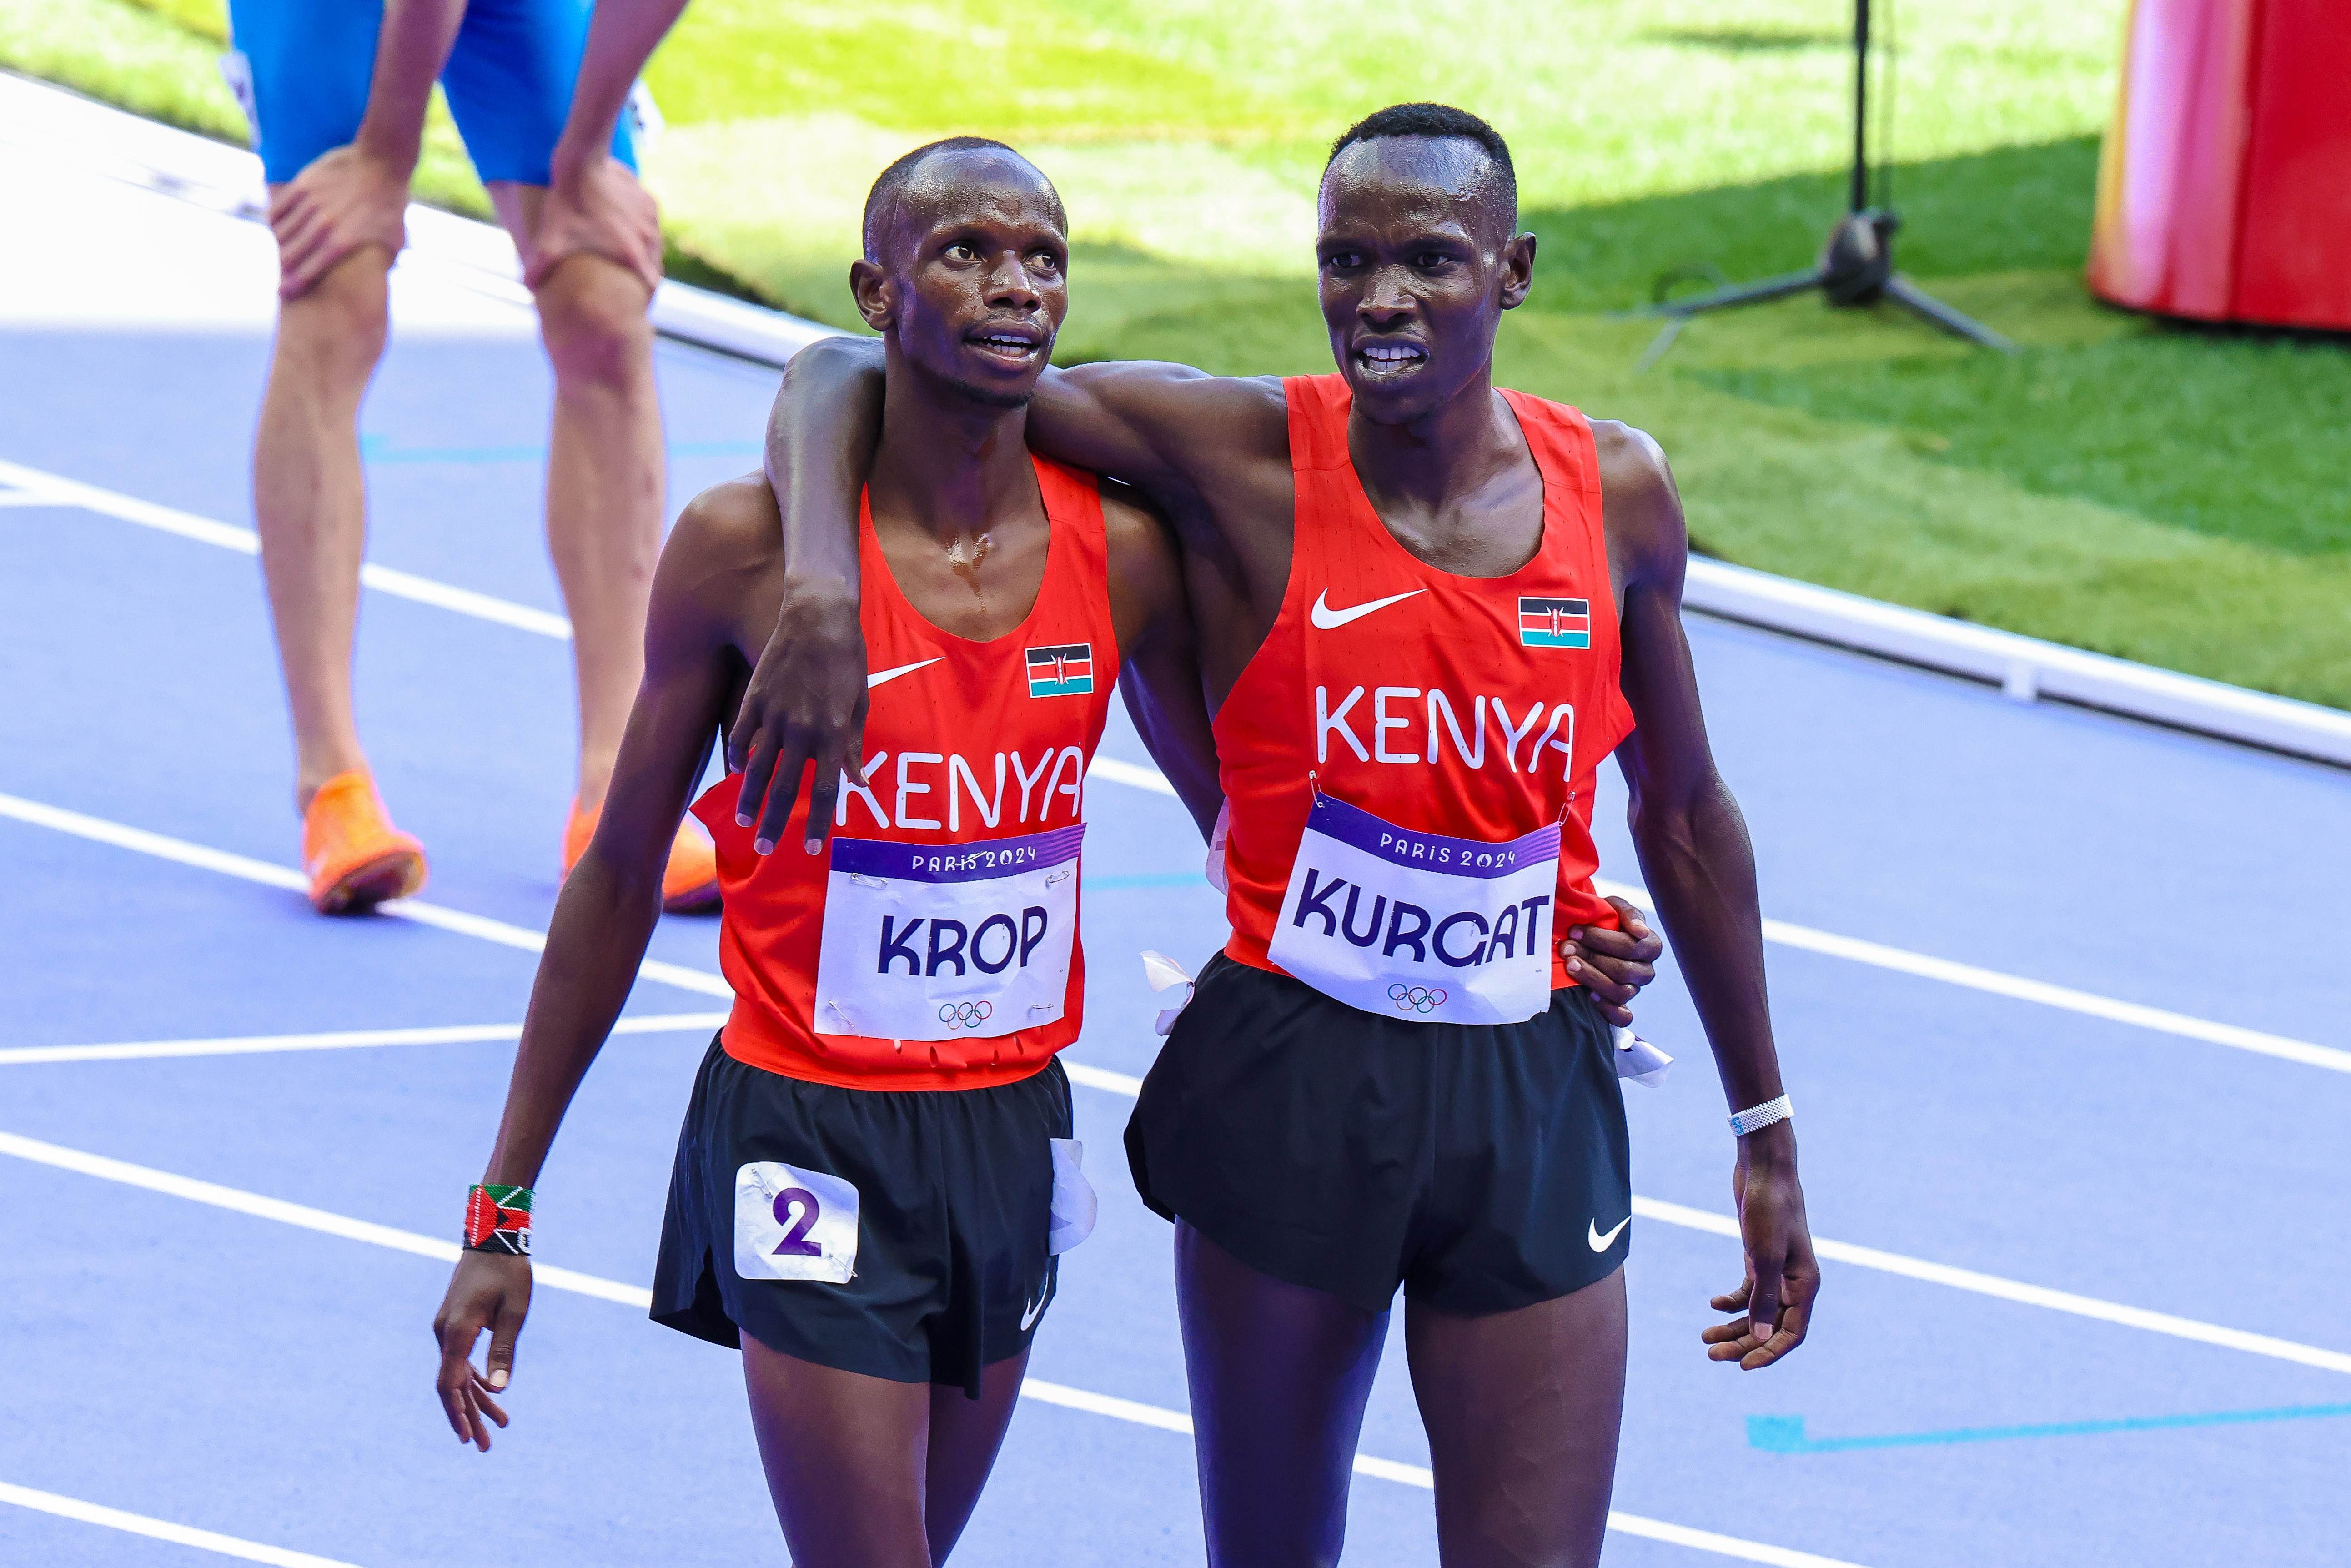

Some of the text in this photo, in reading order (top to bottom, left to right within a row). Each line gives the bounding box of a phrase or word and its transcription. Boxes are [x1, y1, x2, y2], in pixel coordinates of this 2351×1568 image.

[1315, 685, 1574, 782] KENYA
[835, 746, 1083, 832] KENYA
[985, 845, 1036, 867] 2024
[1459, 851, 1516, 868] 2024
[877, 905, 1047, 977] KROP
[1292, 868, 1550, 967] KURGAT
[771, 1187, 822, 1257] 2
